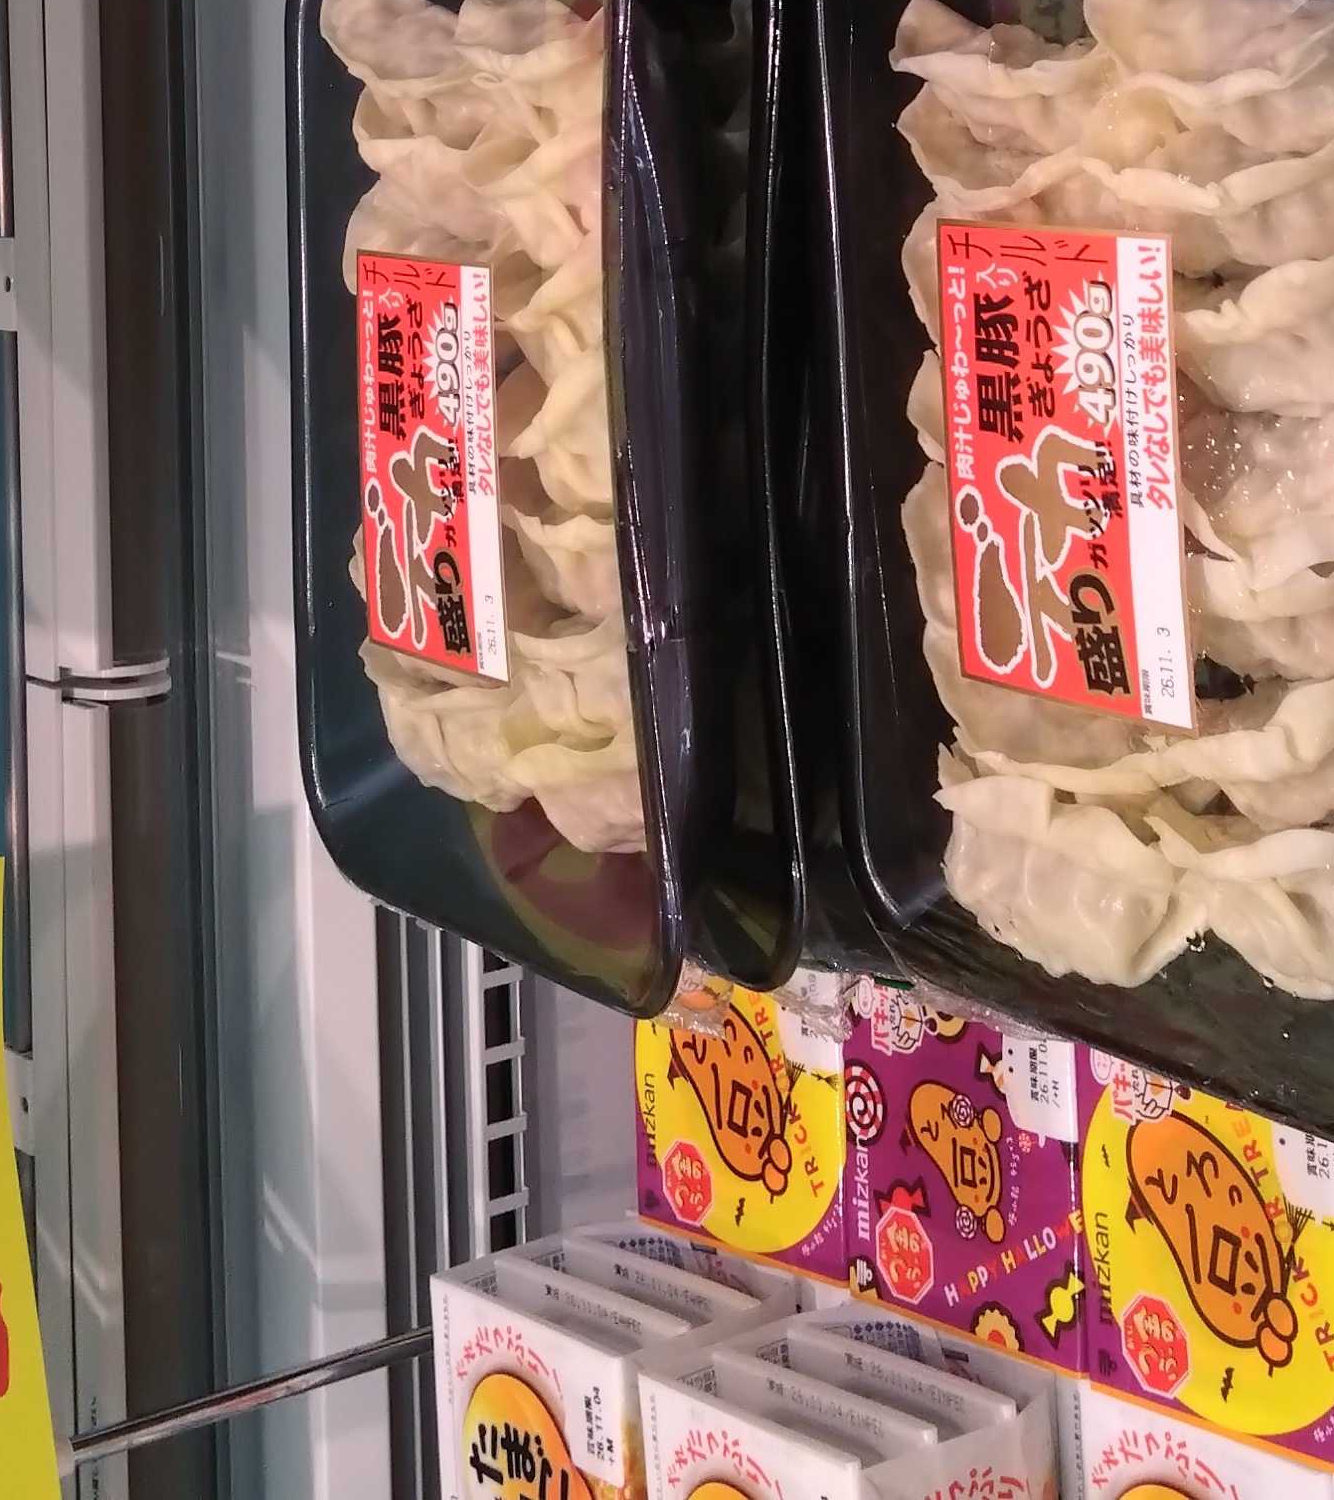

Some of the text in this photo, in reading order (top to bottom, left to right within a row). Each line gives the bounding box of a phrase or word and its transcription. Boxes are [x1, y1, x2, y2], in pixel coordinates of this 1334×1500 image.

[947, 231, 1110, 266] チルド
[377, 315, 406, 440] 黒豚
[405, 294, 425, 420] ぎょうざ
[434, 300, 461, 425] 490g
[973, 293, 1024, 444] 黒豚
[1021, 270, 1057, 419] ぎょうざ
[1072, 280, 1116, 425] 490g
[433, 549, 472, 653] 盛り
[1066, 571, 1132, 696] 盛り
[852, 1136, 871, 1241] mizkan
[1092, 1211, 1116, 1325] mizkan
